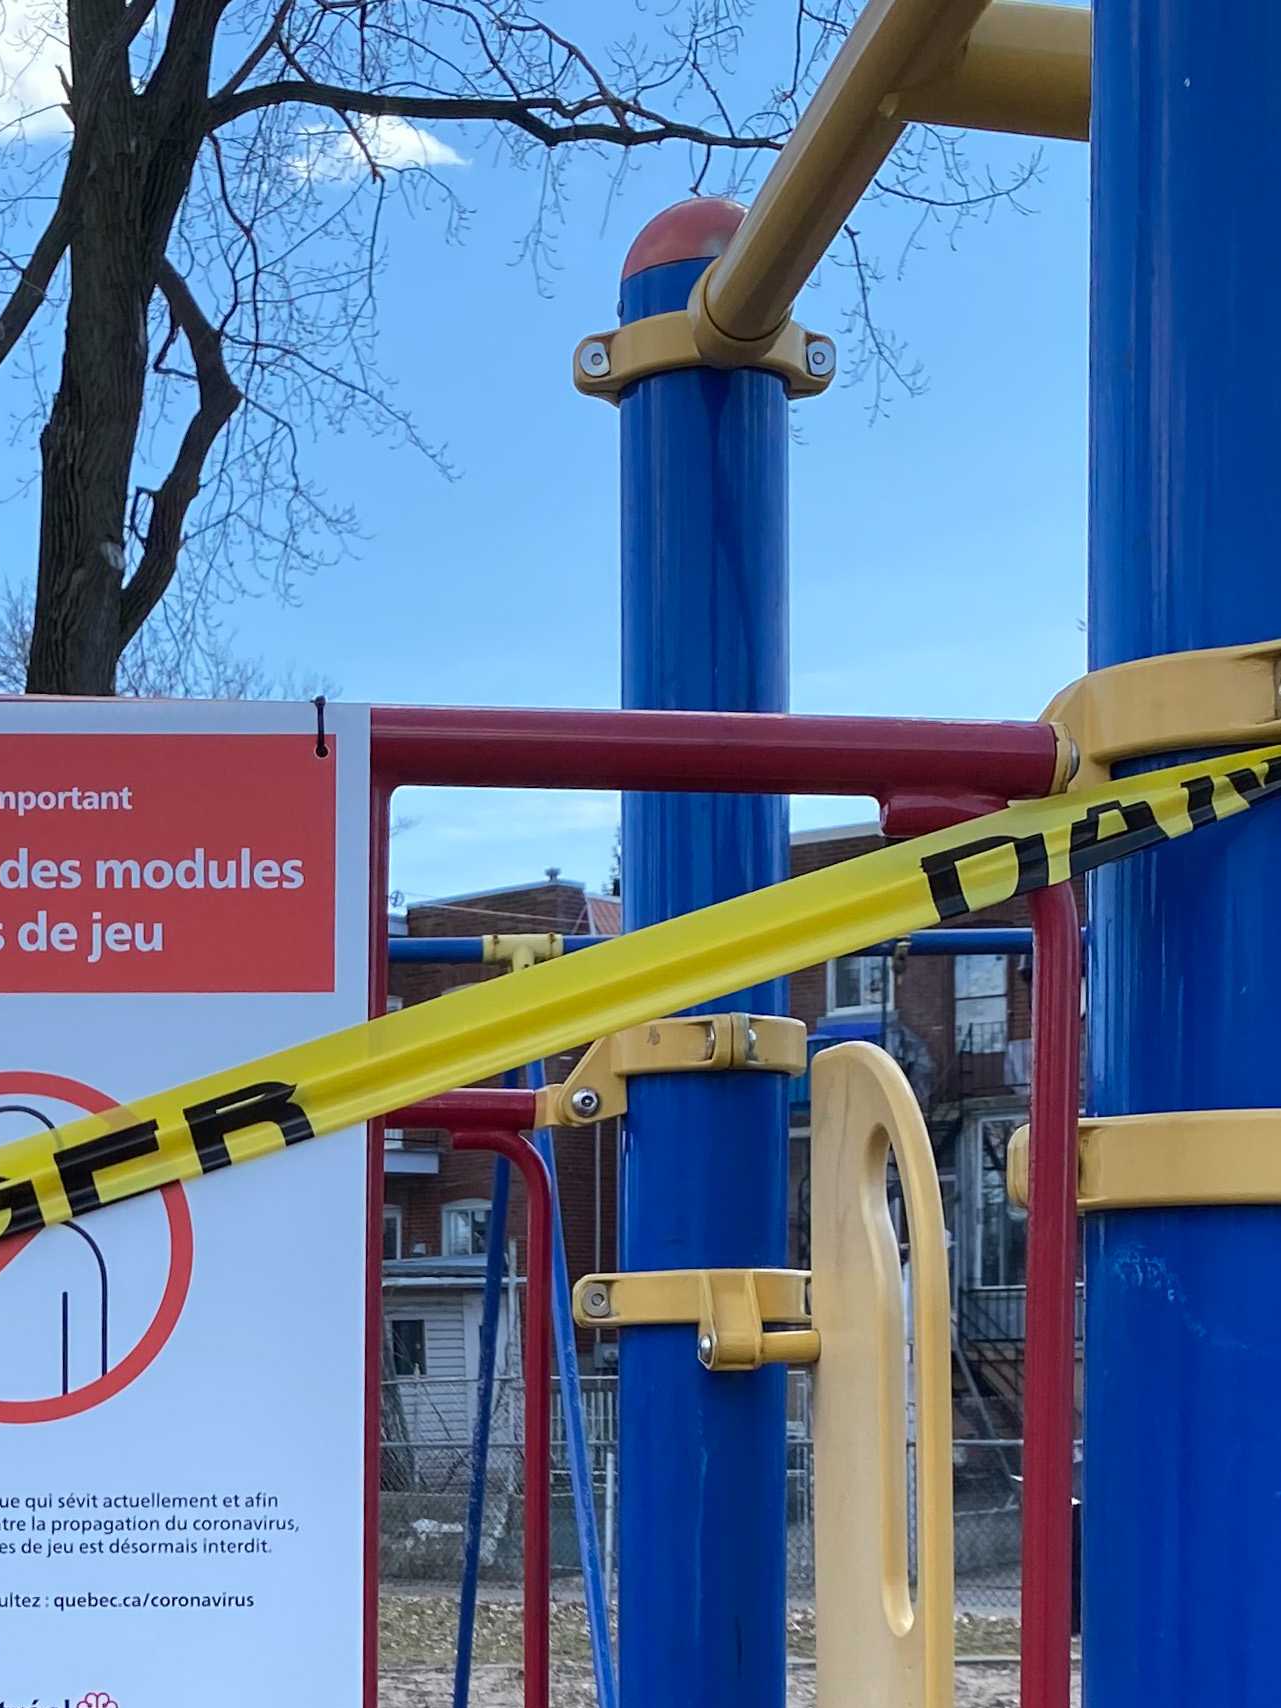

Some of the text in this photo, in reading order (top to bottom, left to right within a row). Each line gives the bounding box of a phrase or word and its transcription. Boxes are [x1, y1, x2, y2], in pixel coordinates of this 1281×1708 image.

[95, 847, 305, 890] modules
[17, 910, 78, 952] de
[87, 911, 163, 963] jeu
[25, 1493, 53, 1513] qui
[57, 1492, 99, 1509] sévit
[102, 1492, 218, 1508] actuellement
[222, 1494, 241, 1508] et
[244, 1491, 278, 1508] afin
[31, 1515, 46, 1532] la
[51, 1515, 160, 1536] propagation
[164, 1515, 188, 1532] du
[192, 1515, 300, 1533] coronavirus,
[20, 1538, 43, 1555] de
[46, 1538, 74, 1559] jeu
[79, 1539, 105, 1555] est
[108, 1537, 198, 1554] désormais
[203, 1537, 272, 1554] interdit.
[53, 1591, 255, 1612] quebec.ca/coronavirus
